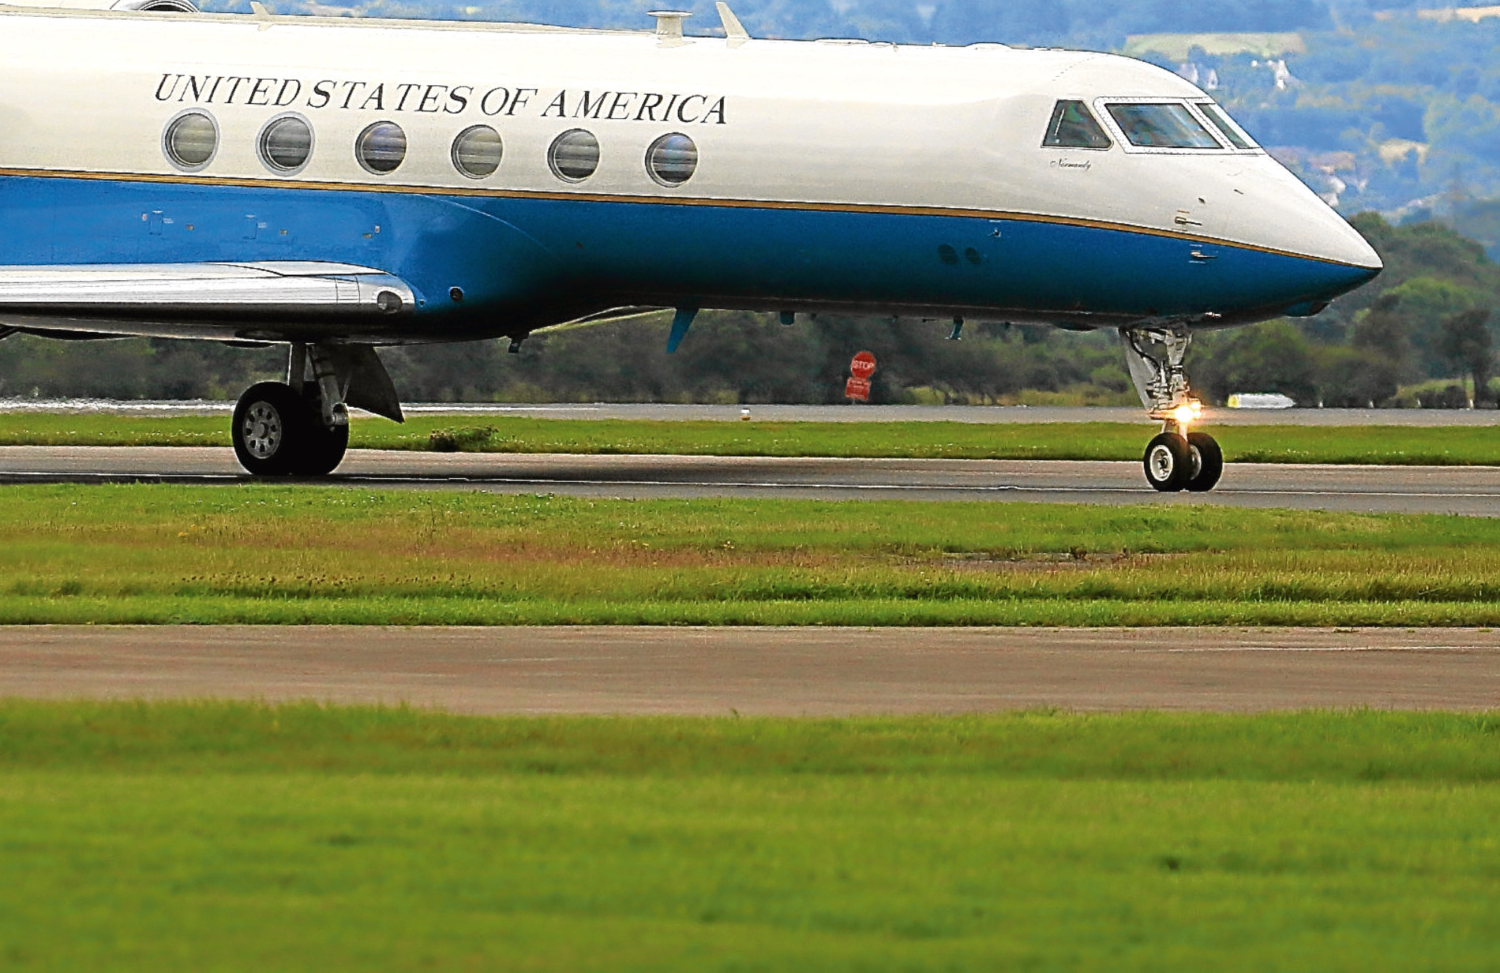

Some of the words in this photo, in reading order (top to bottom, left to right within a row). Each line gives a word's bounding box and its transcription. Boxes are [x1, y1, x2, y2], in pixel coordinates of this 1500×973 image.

[153, 73, 302, 107] UNITED
[305, 79, 475, 115] STATES
[480, 86, 539, 117] OF
[539, 88, 728, 125] AMERICA
[852, 360, 875, 370] STOP
